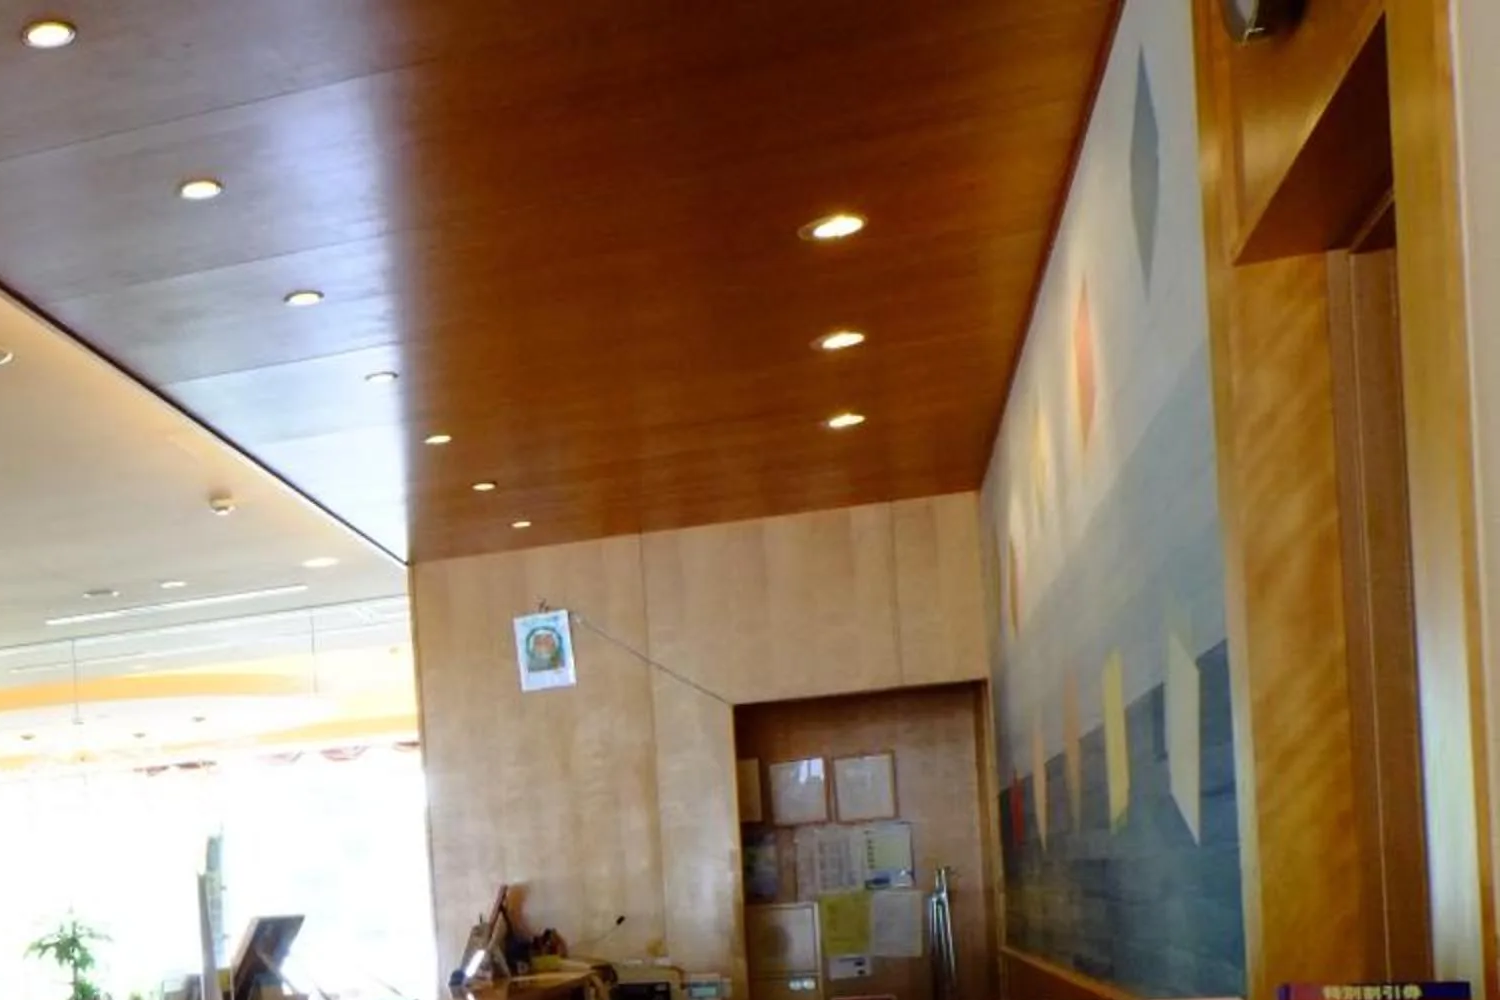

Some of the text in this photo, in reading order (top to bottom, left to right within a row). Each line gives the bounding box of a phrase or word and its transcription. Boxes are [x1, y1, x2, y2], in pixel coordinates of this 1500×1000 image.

[1323, 985, 1422, 1000] 特別割引券
